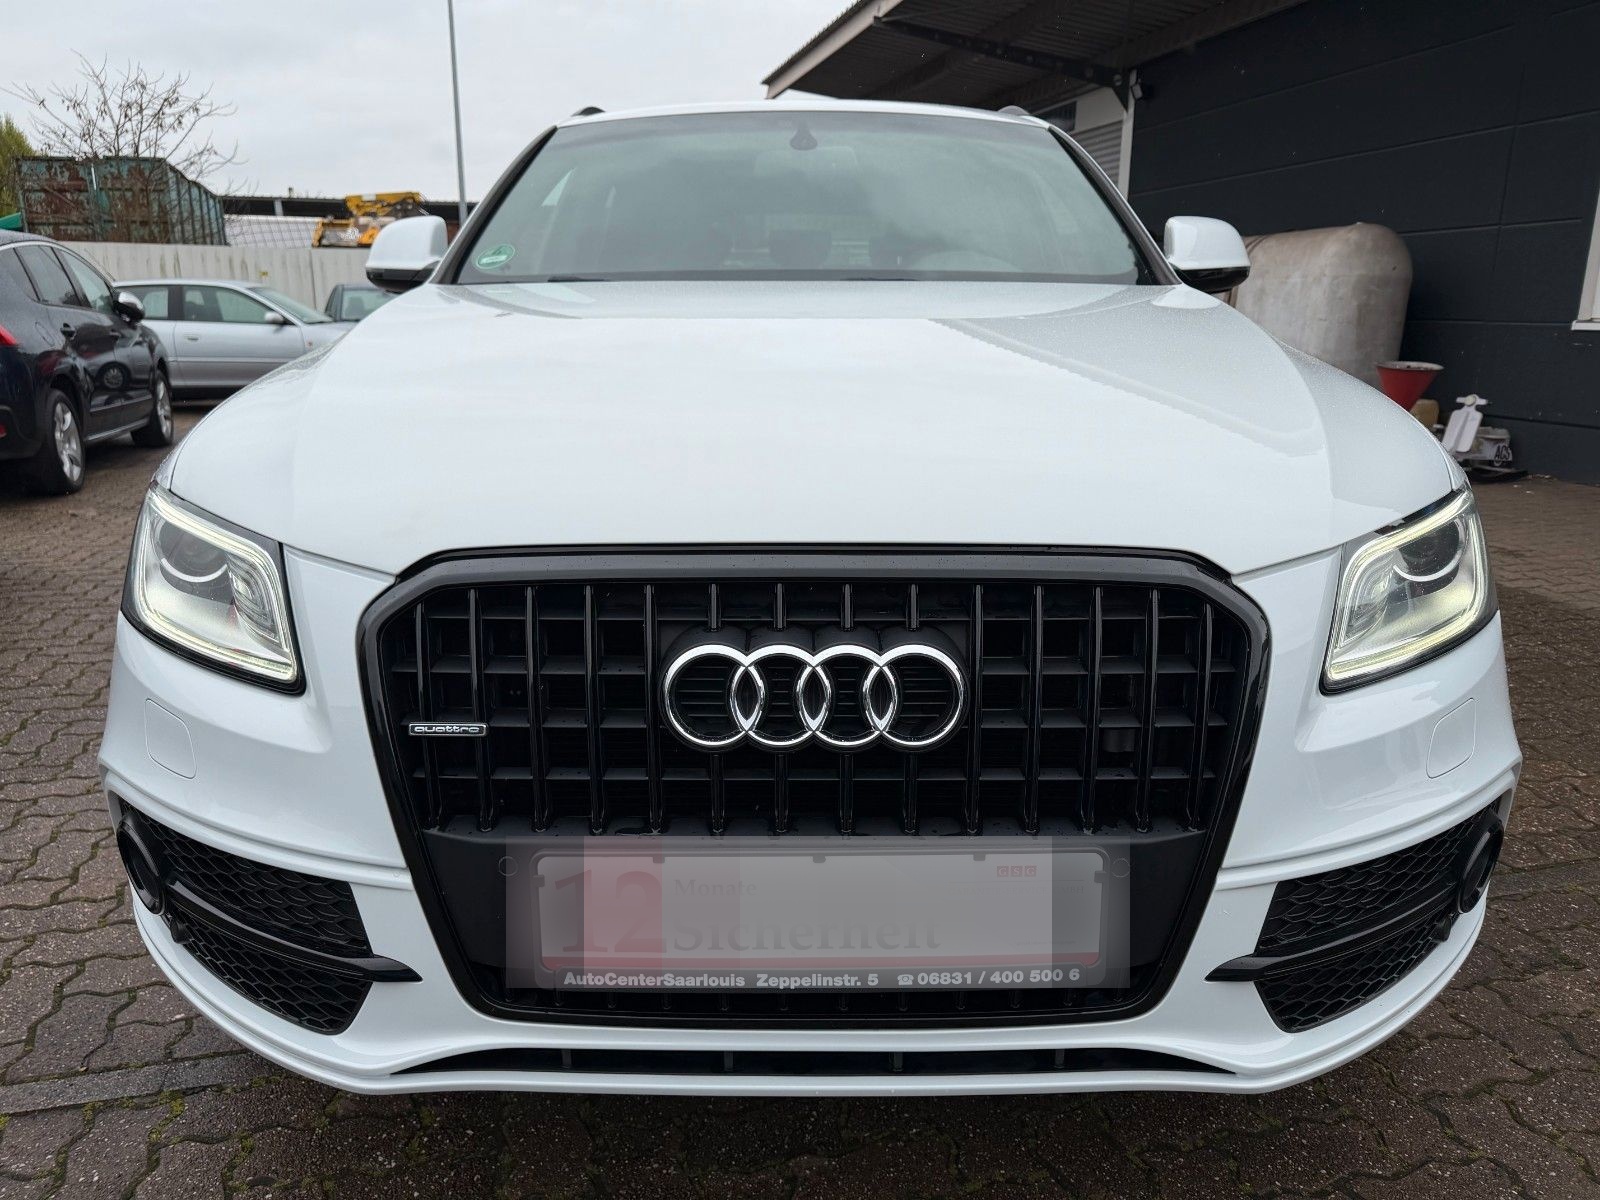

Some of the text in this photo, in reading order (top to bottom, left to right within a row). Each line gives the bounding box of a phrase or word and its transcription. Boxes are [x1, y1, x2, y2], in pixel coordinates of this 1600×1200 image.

[414, 725, 480, 733] quattro
[997, 865, 1037, 878] GSG
[555, 868, 758, 953] 12 Monate
[674, 917, 942, 952] Sicherheit
[563, 971, 879, 990] AutoCenterSaarlouis Zeppelinstr. 5
[916, 968, 1081, 986] 06831 / 400 500 6
